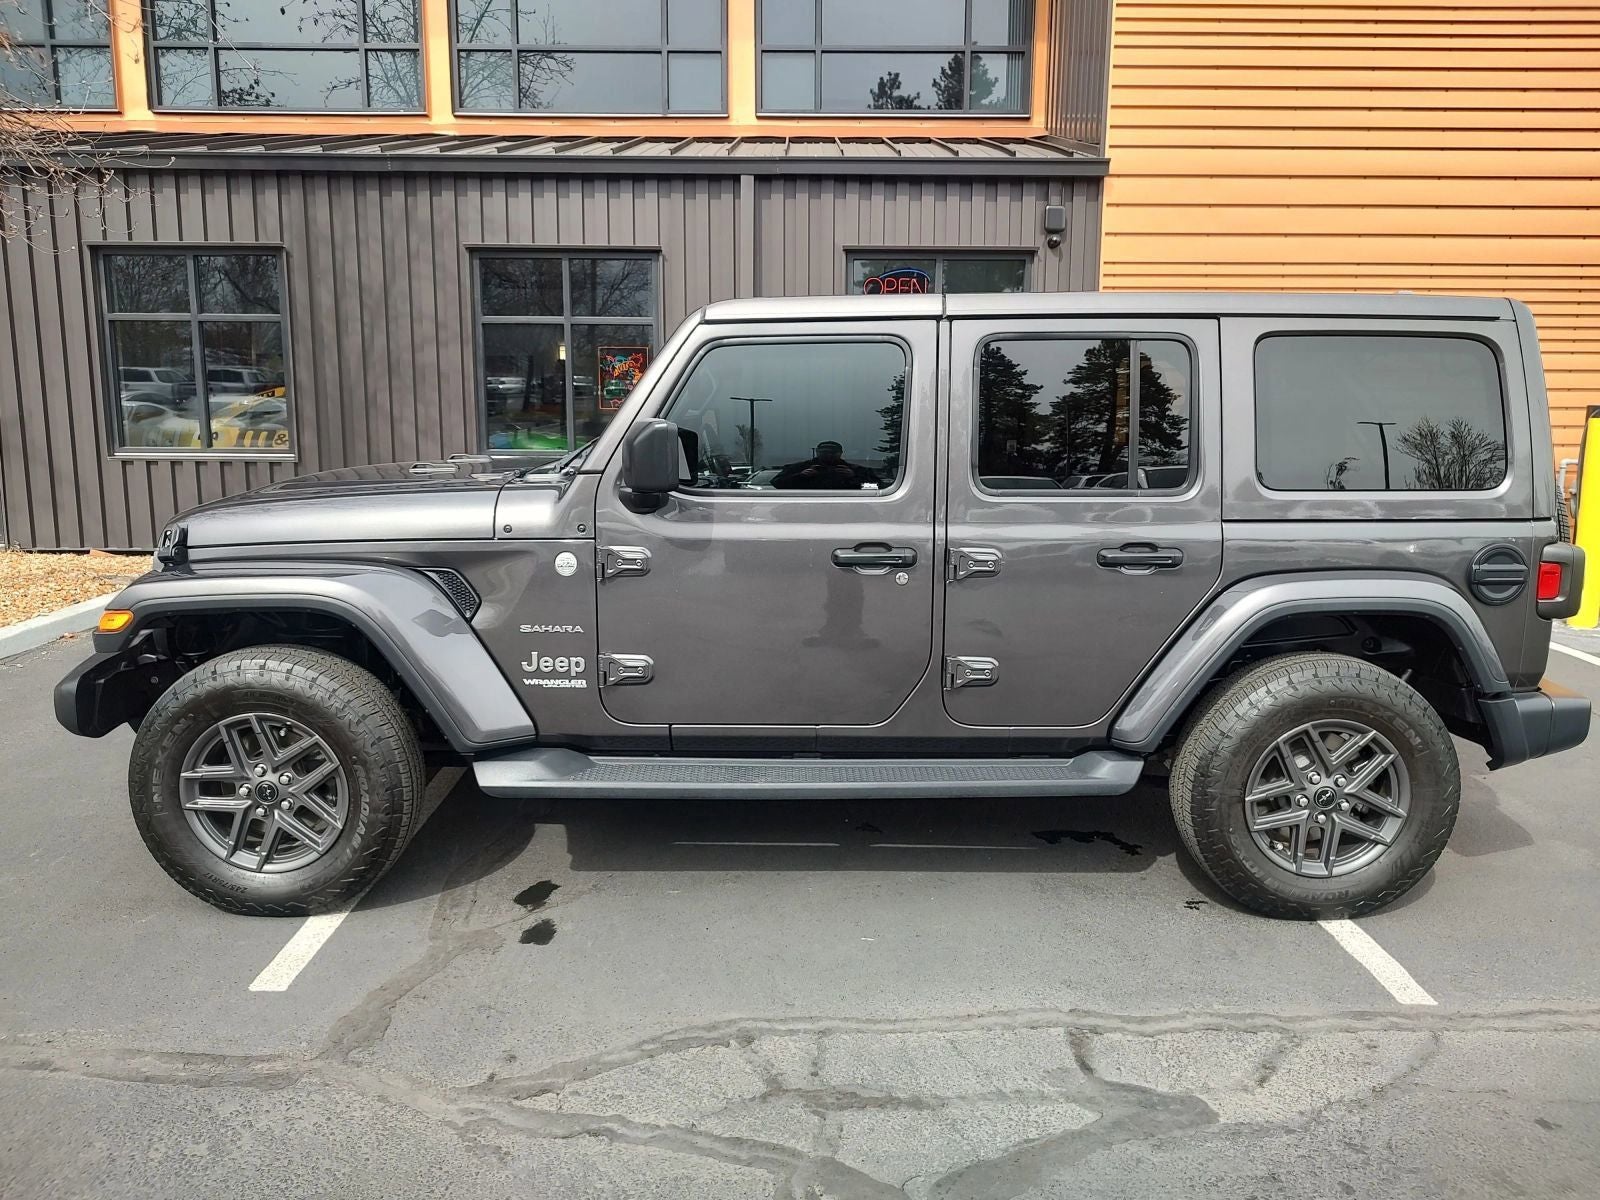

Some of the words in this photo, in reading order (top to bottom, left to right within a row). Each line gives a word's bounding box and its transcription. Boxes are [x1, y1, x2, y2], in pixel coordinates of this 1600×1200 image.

[863, 277, 928, 294] OPEN
[519, 624, 584, 633] SAHARA
[521, 651, 586, 677] Jeep
